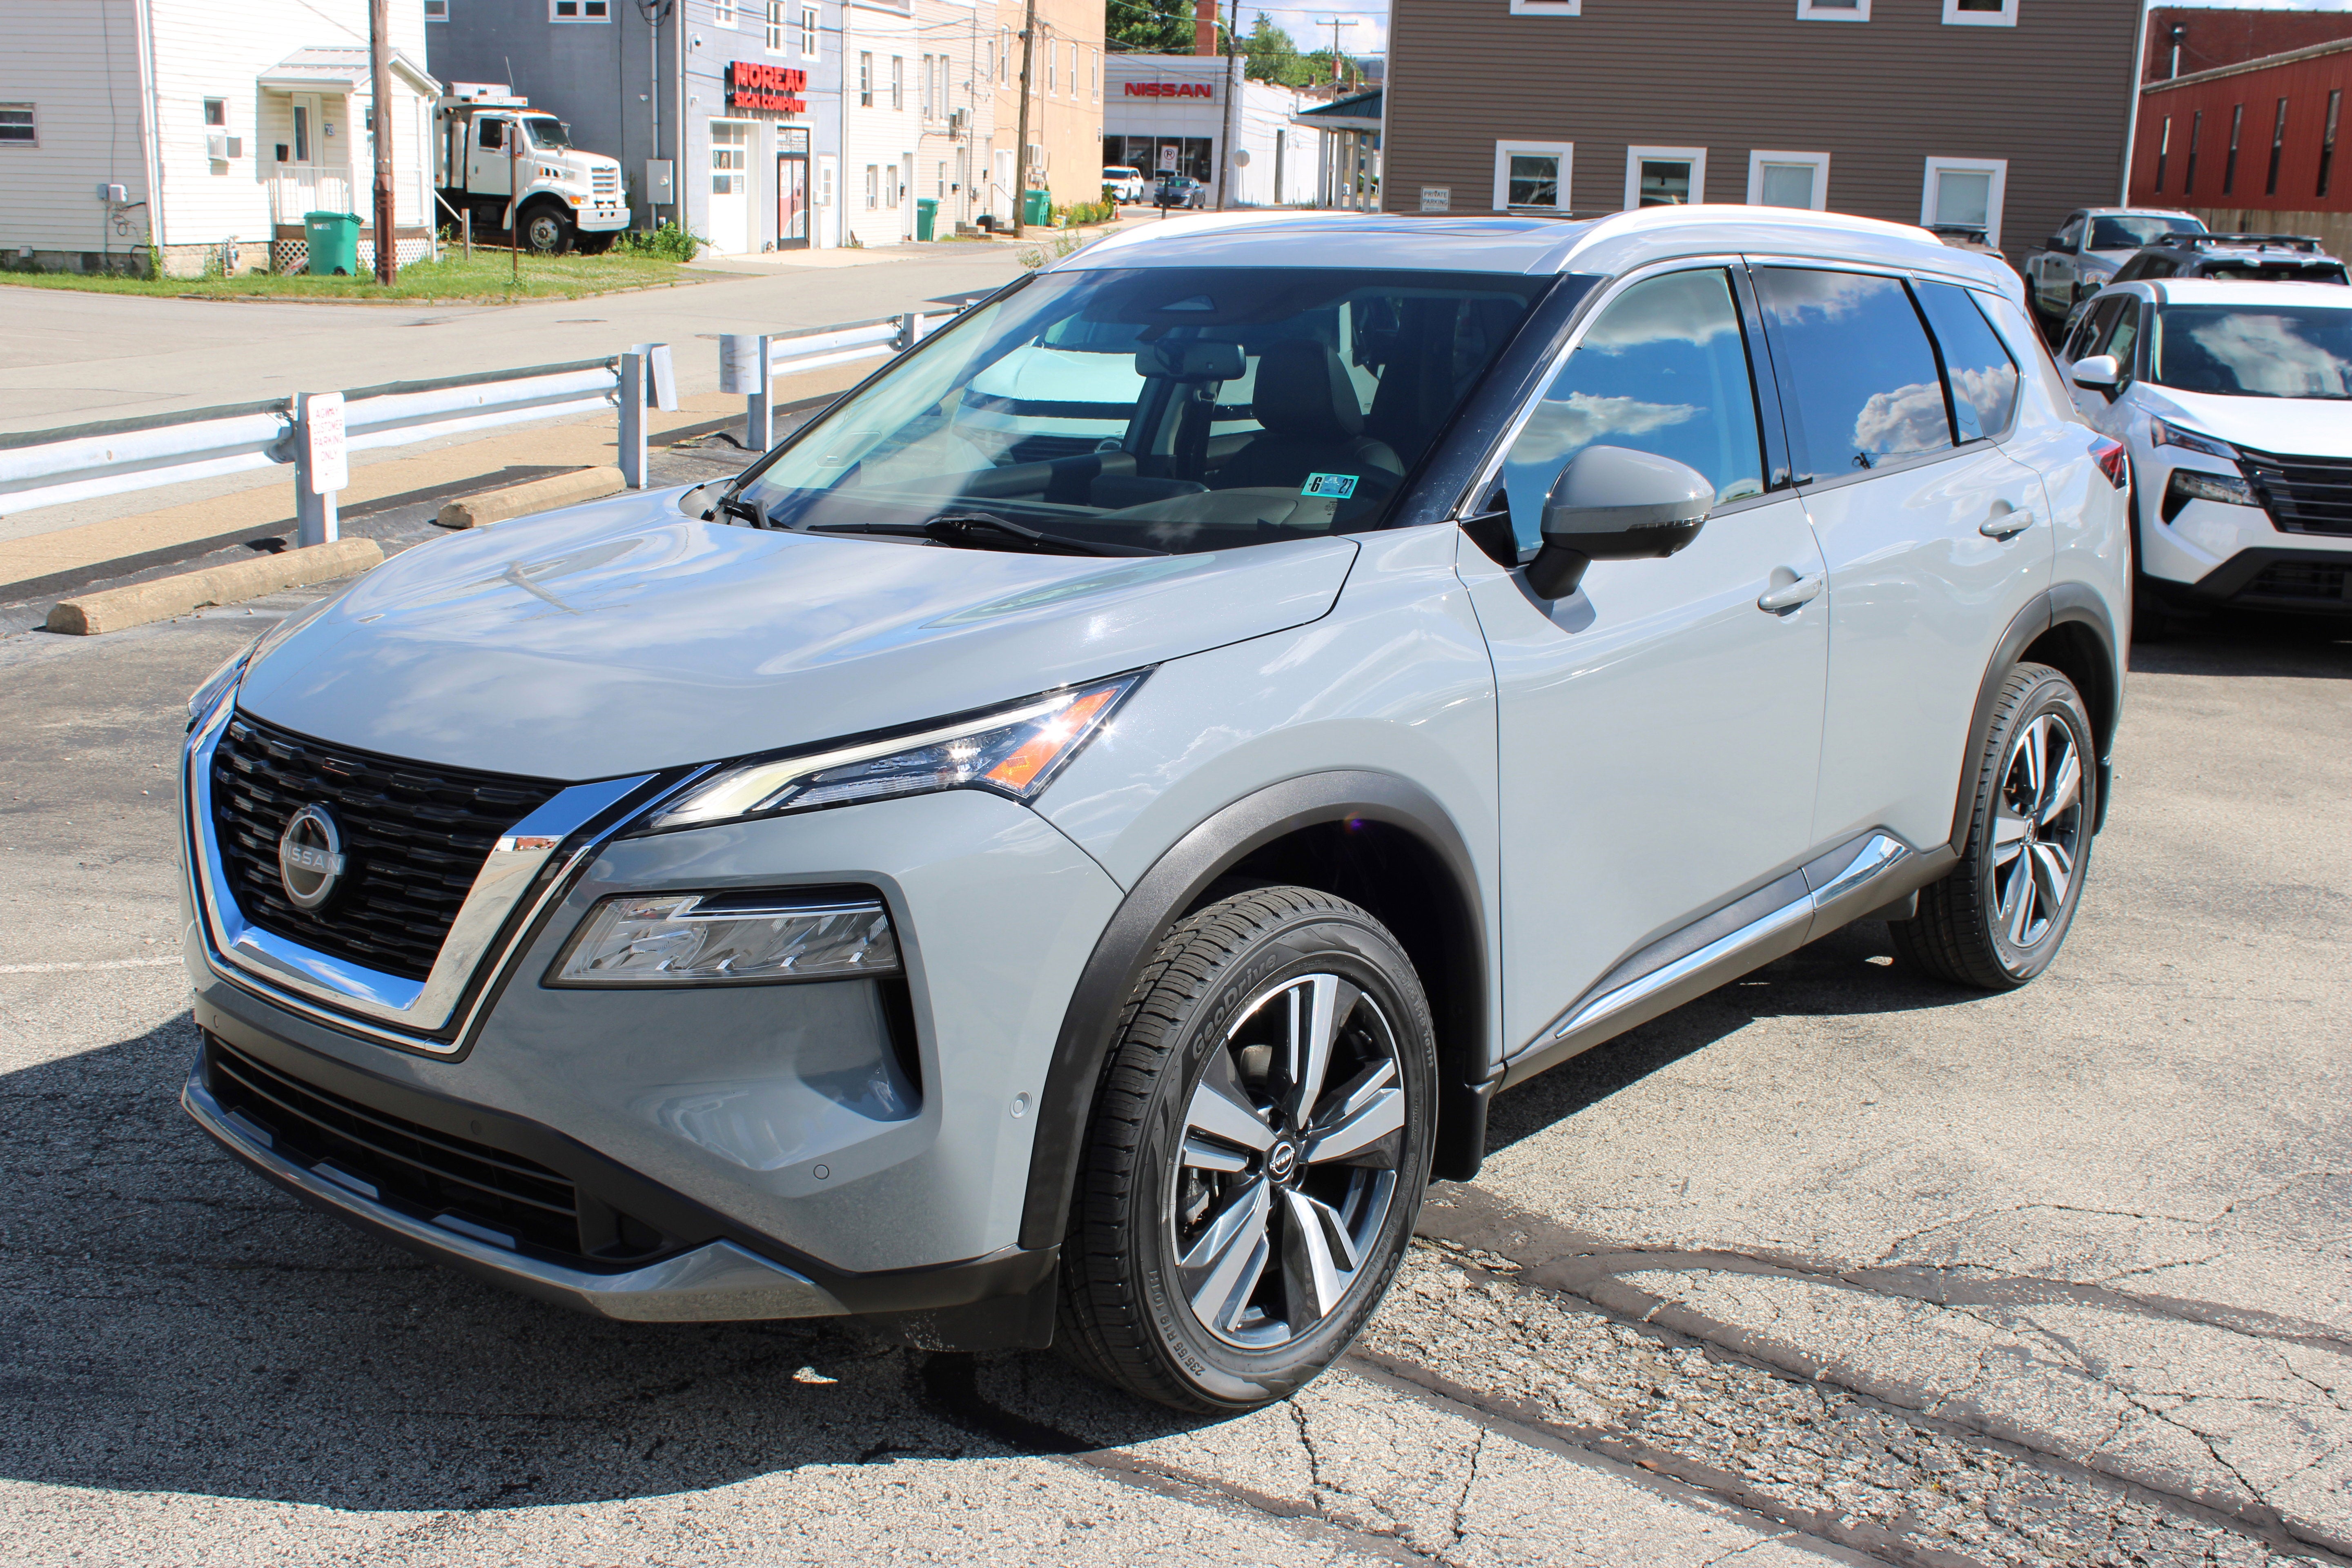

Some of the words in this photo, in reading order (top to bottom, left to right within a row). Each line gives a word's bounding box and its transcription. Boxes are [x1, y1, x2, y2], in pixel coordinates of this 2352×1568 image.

[734, 60, 806, 92] MOREAU
[1125, 82, 1211, 97] NISSAN
[734, 91, 760, 108] SIGN
[762, 94, 807, 113] COMPANY
[316, 406, 339, 419] AGWAY
[313, 419, 343, 434] CUSTOMER
[314, 434, 343, 448] PARKING
[321, 448, 338, 461] ONLY
[1310, 477, 1323, 492] 6
[1338, 478, 1354, 495] 27
[281, 843, 341, 871] NISSAN
[1193, 954, 1276, 1060] GeoDrive
[1423, 1030, 1434, 1067] 101H
[1269, 1148, 1295, 1170] NISSAN
[1149, 1270, 1164, 1311] 101H
[1160, 1314, 1178, 1342] R19
[1173, 1341, 1206, 1376] 235/55
